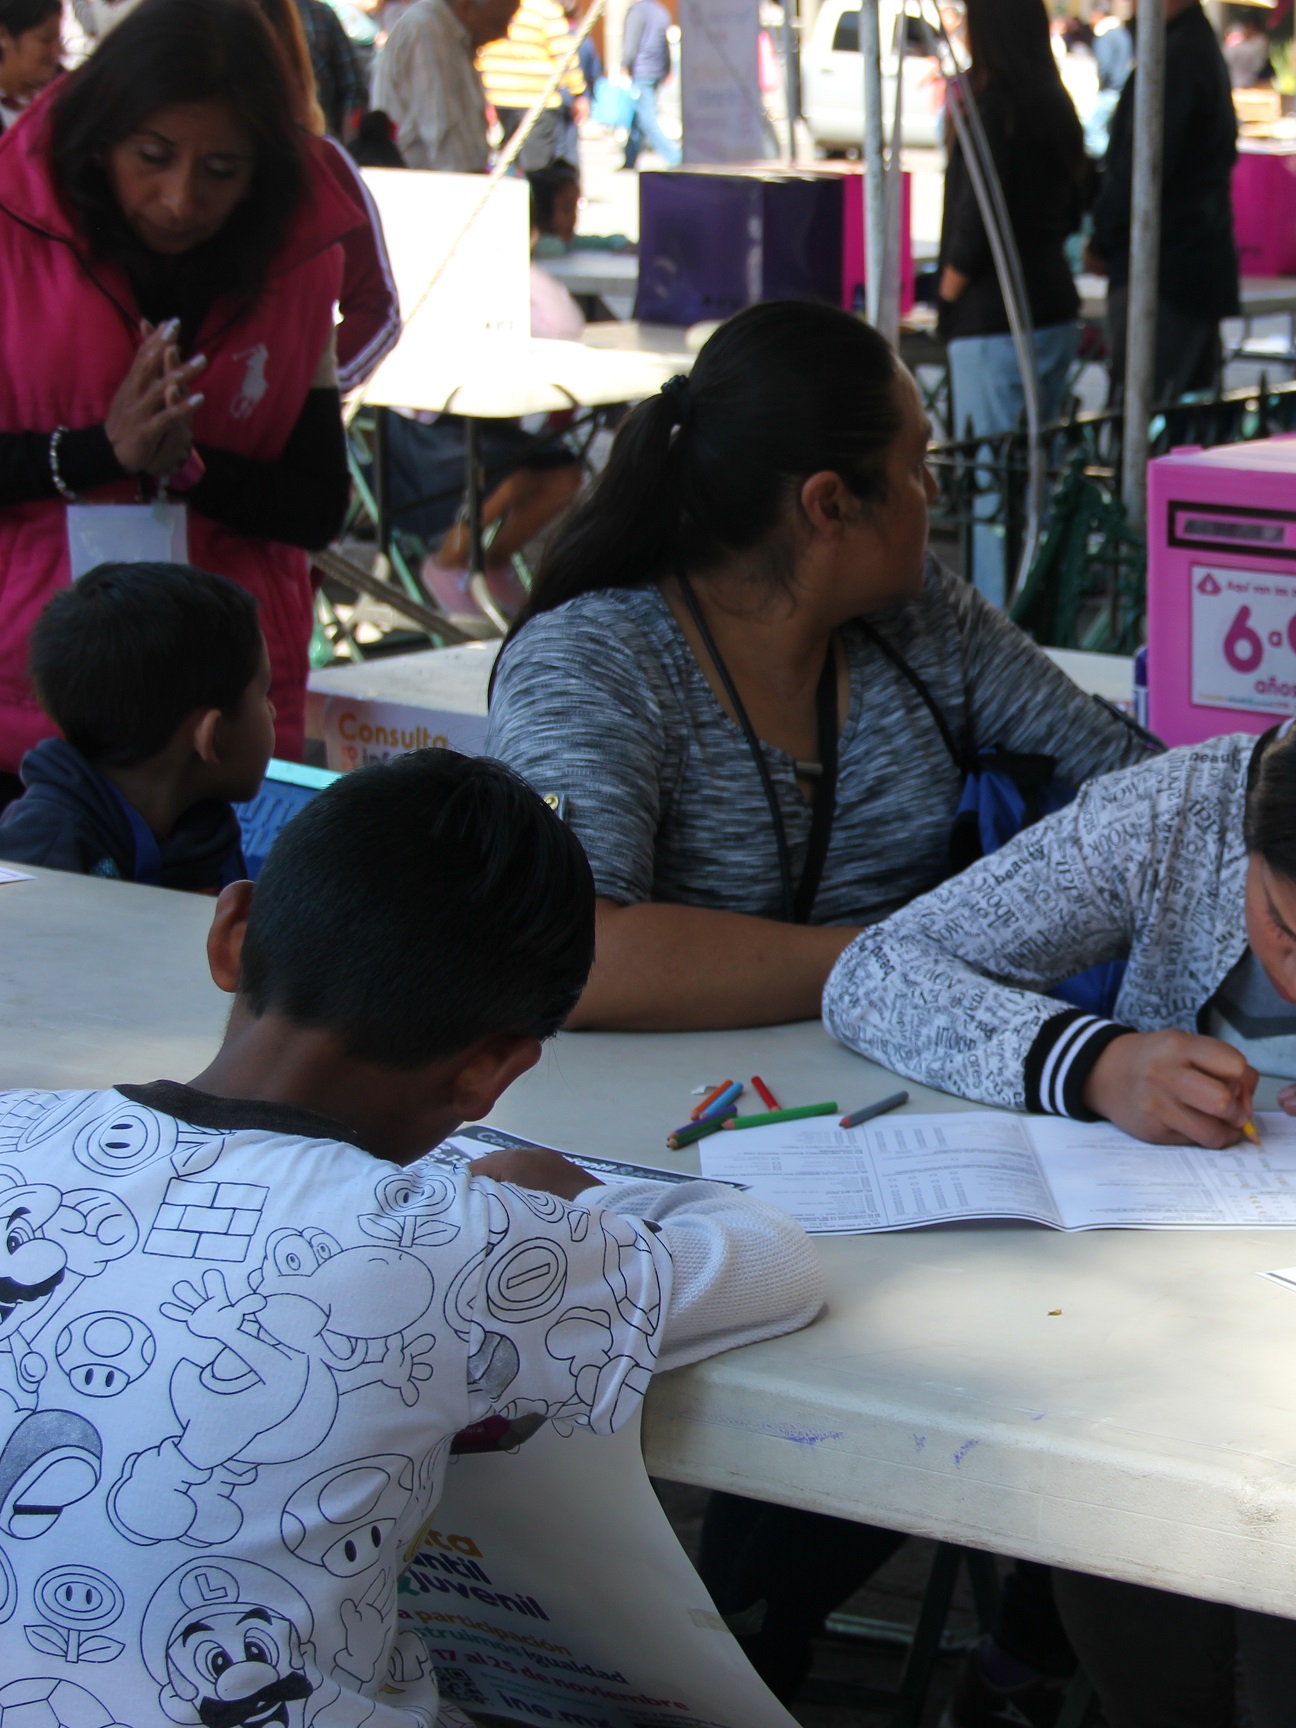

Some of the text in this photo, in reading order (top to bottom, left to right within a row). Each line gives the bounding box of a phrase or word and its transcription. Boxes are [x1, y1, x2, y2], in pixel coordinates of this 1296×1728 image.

[1224, 605, 1264, 674] 6
[1268, 627, 1283, 647] a
[338, 711, 447, 750] Consulta
[195, 1573, 229, 1601] L
[464, 1650, 488, 1665] al
[486, 1655, 518, 1674] 25
[520, 1666, 552, 1685] de
[552, 1676, 690, 1711] noviembre
